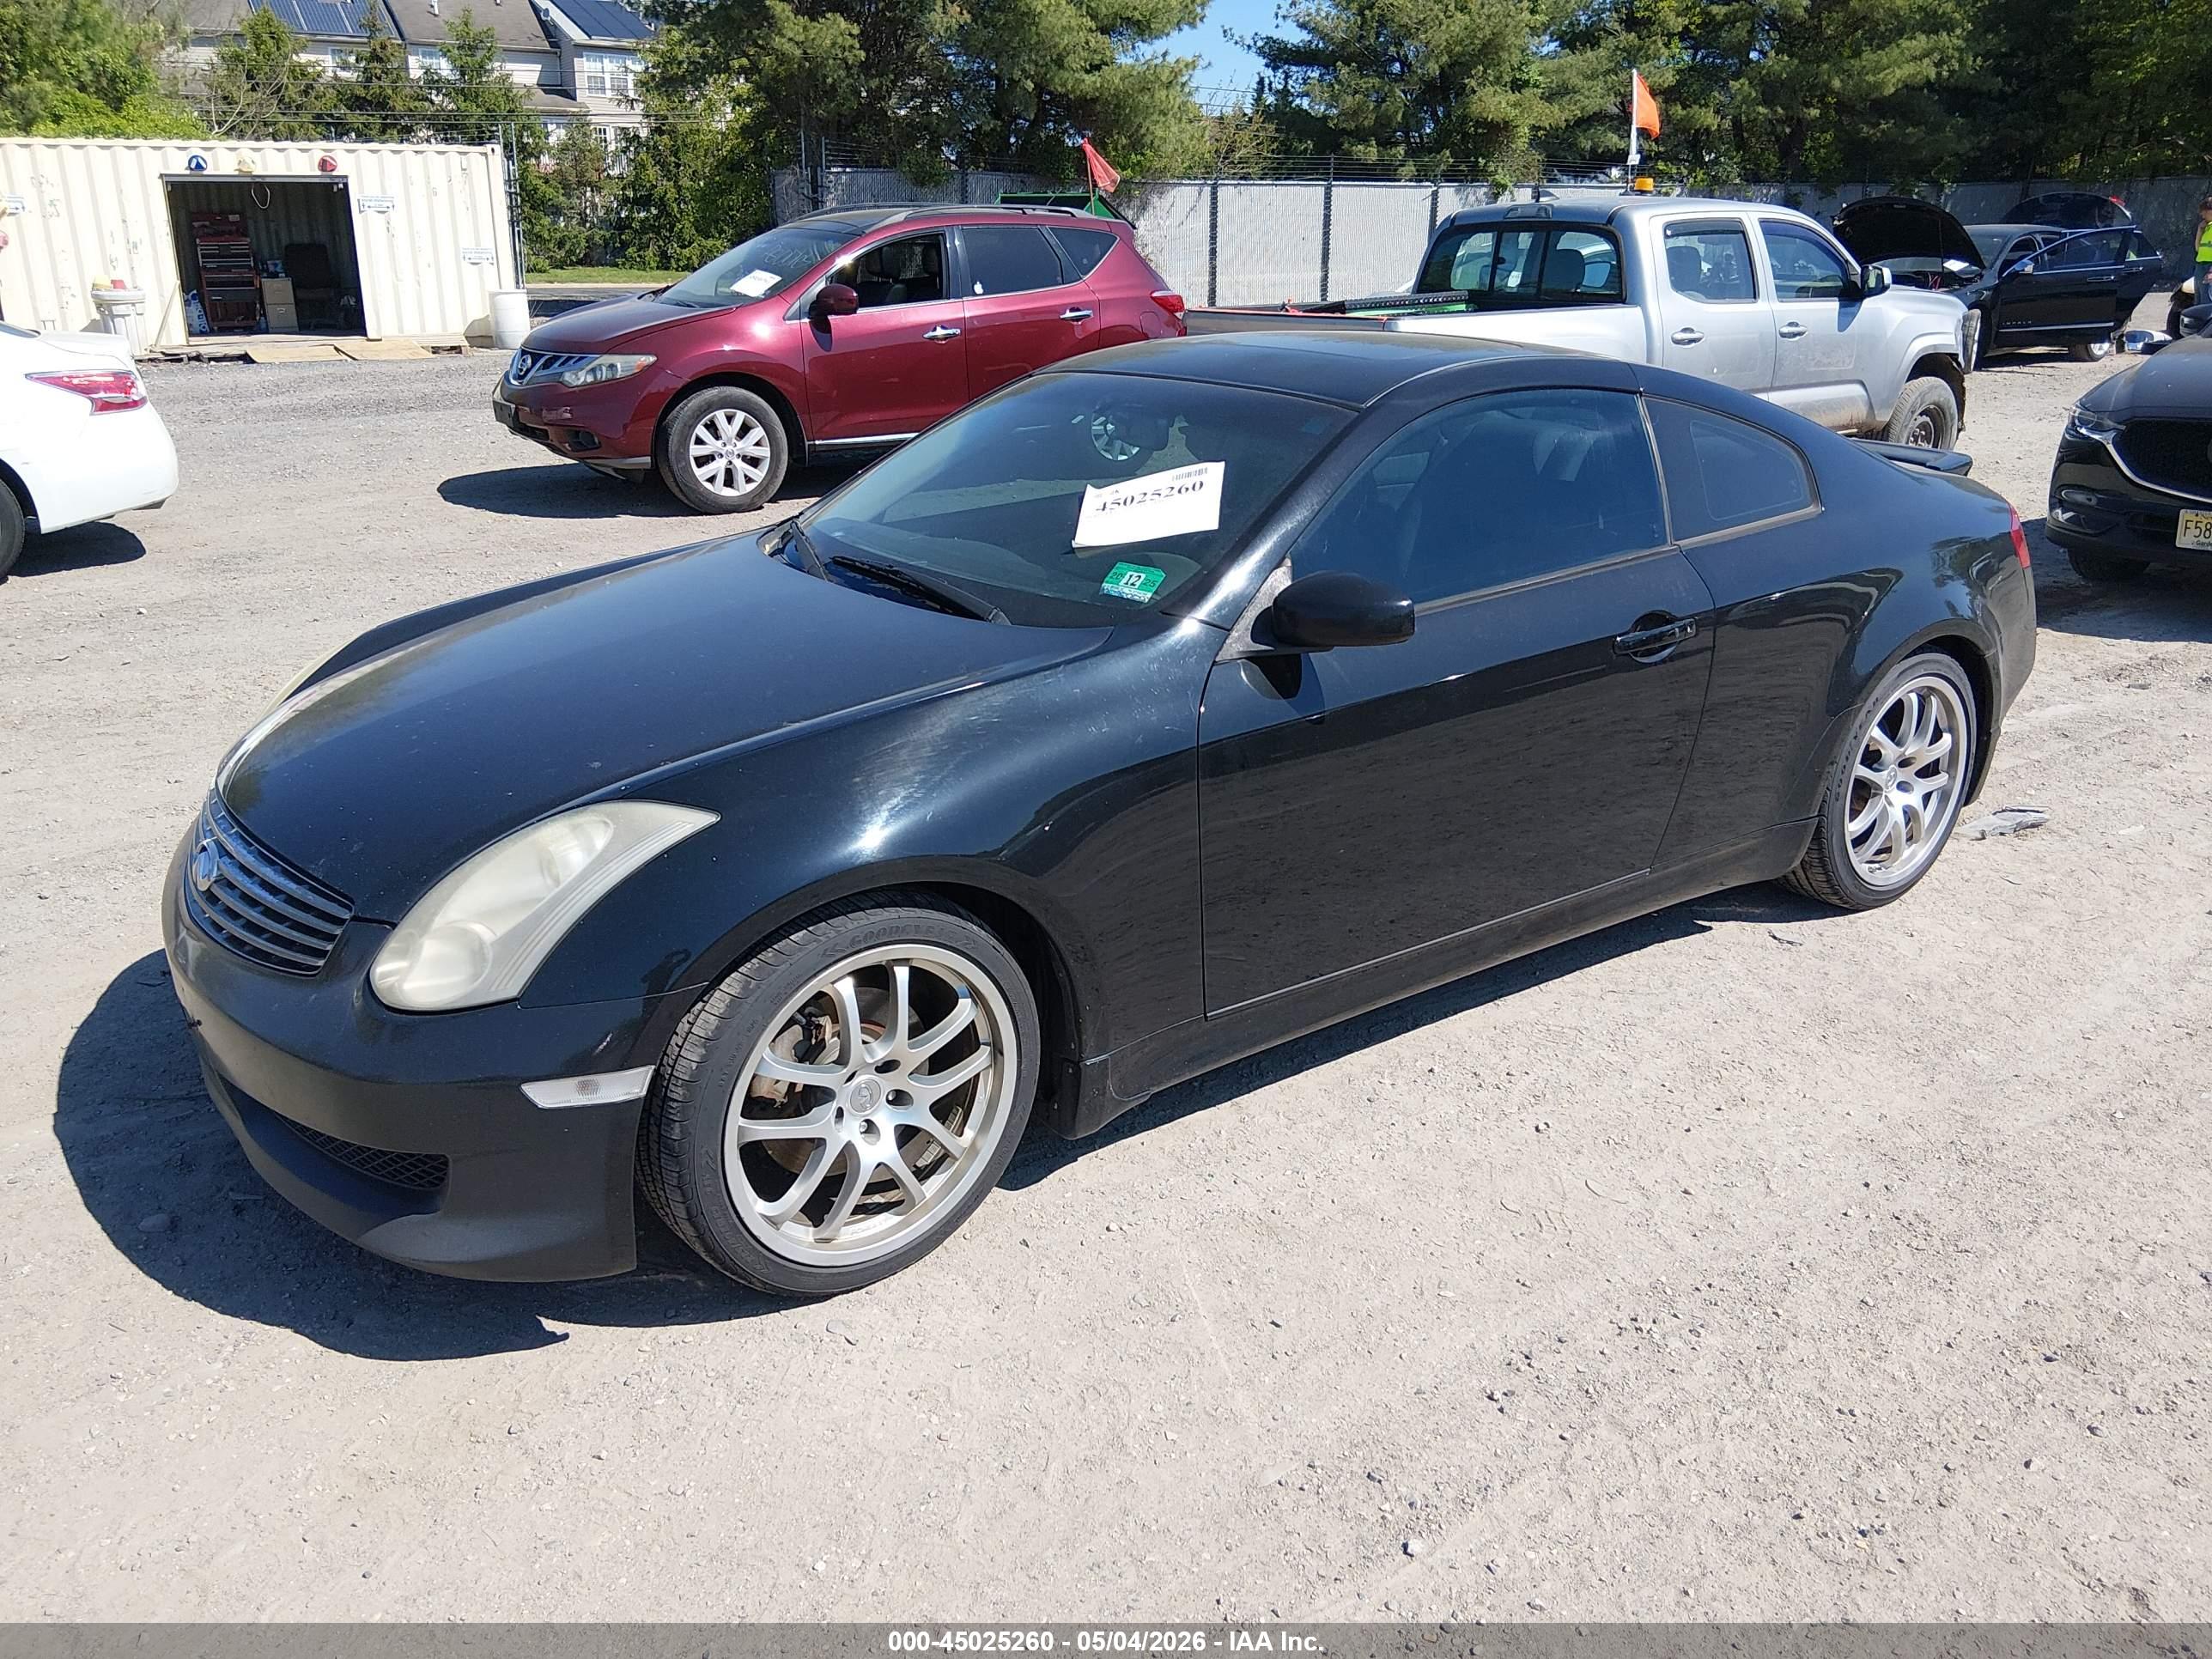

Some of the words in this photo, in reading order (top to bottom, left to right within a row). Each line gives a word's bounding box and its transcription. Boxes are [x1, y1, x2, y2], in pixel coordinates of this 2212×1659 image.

[1096, 480, 1204, 512] 45025260
[1123, 574, 1142, 586] 12
[1143, 578, 1158, 588] 25
